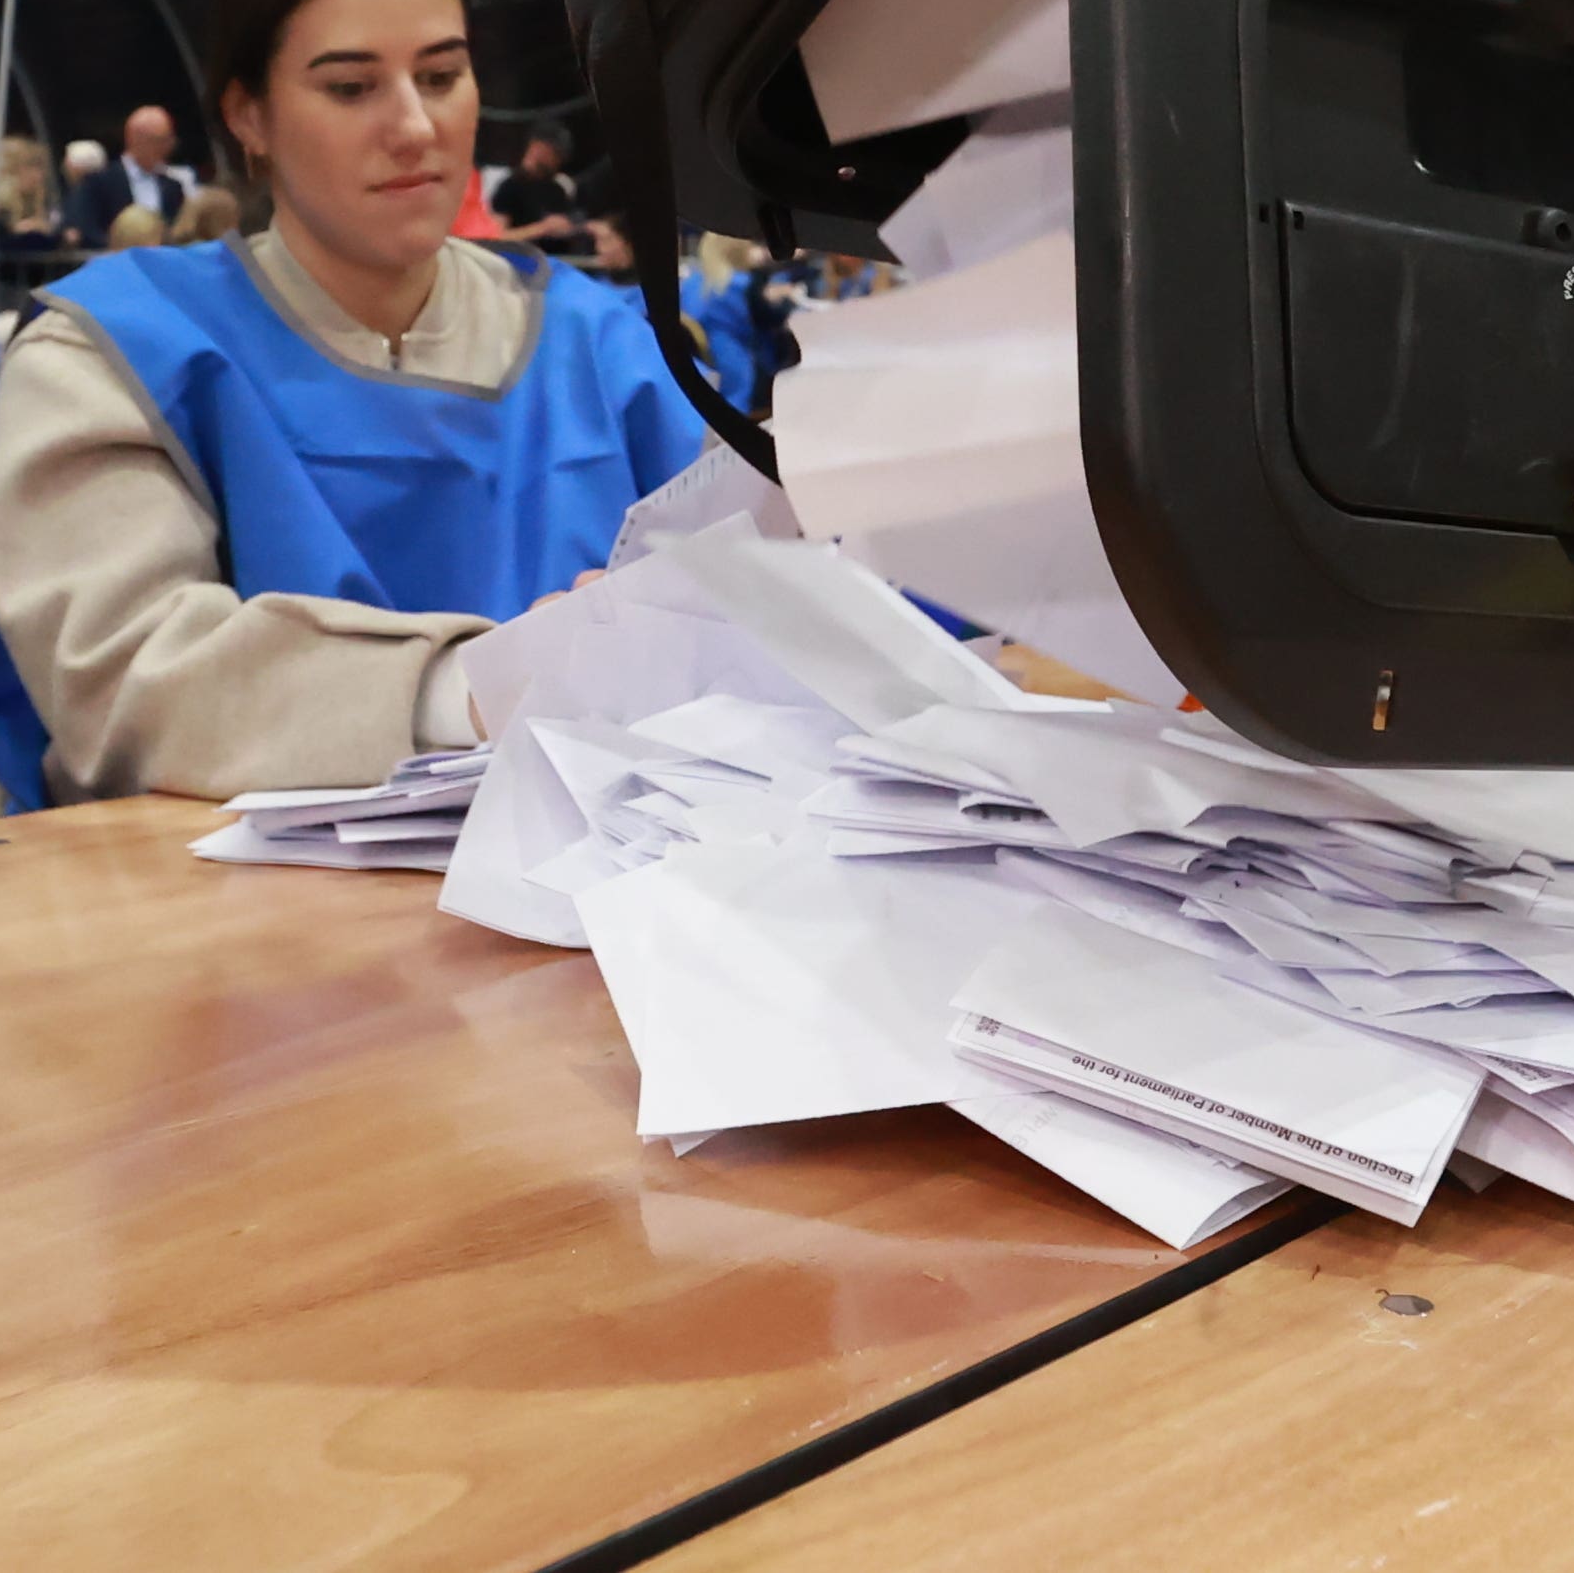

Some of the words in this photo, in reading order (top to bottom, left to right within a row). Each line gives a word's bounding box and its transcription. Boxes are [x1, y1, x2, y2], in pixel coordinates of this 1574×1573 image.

[1072, 1055, 1097, 1071] the
[1099, 1065, 1122, 1081] for
[1123, 1074, 1205, 1110] Parliament
[1207, 1105, 1226, 1115] of
[1228, 1109, 1293, 1141] Member
[1297, 1134, 1323, 1151] the
[1325, 1143, 1343, 1157] of
[1347, 1153, 1414, 1185] Election
